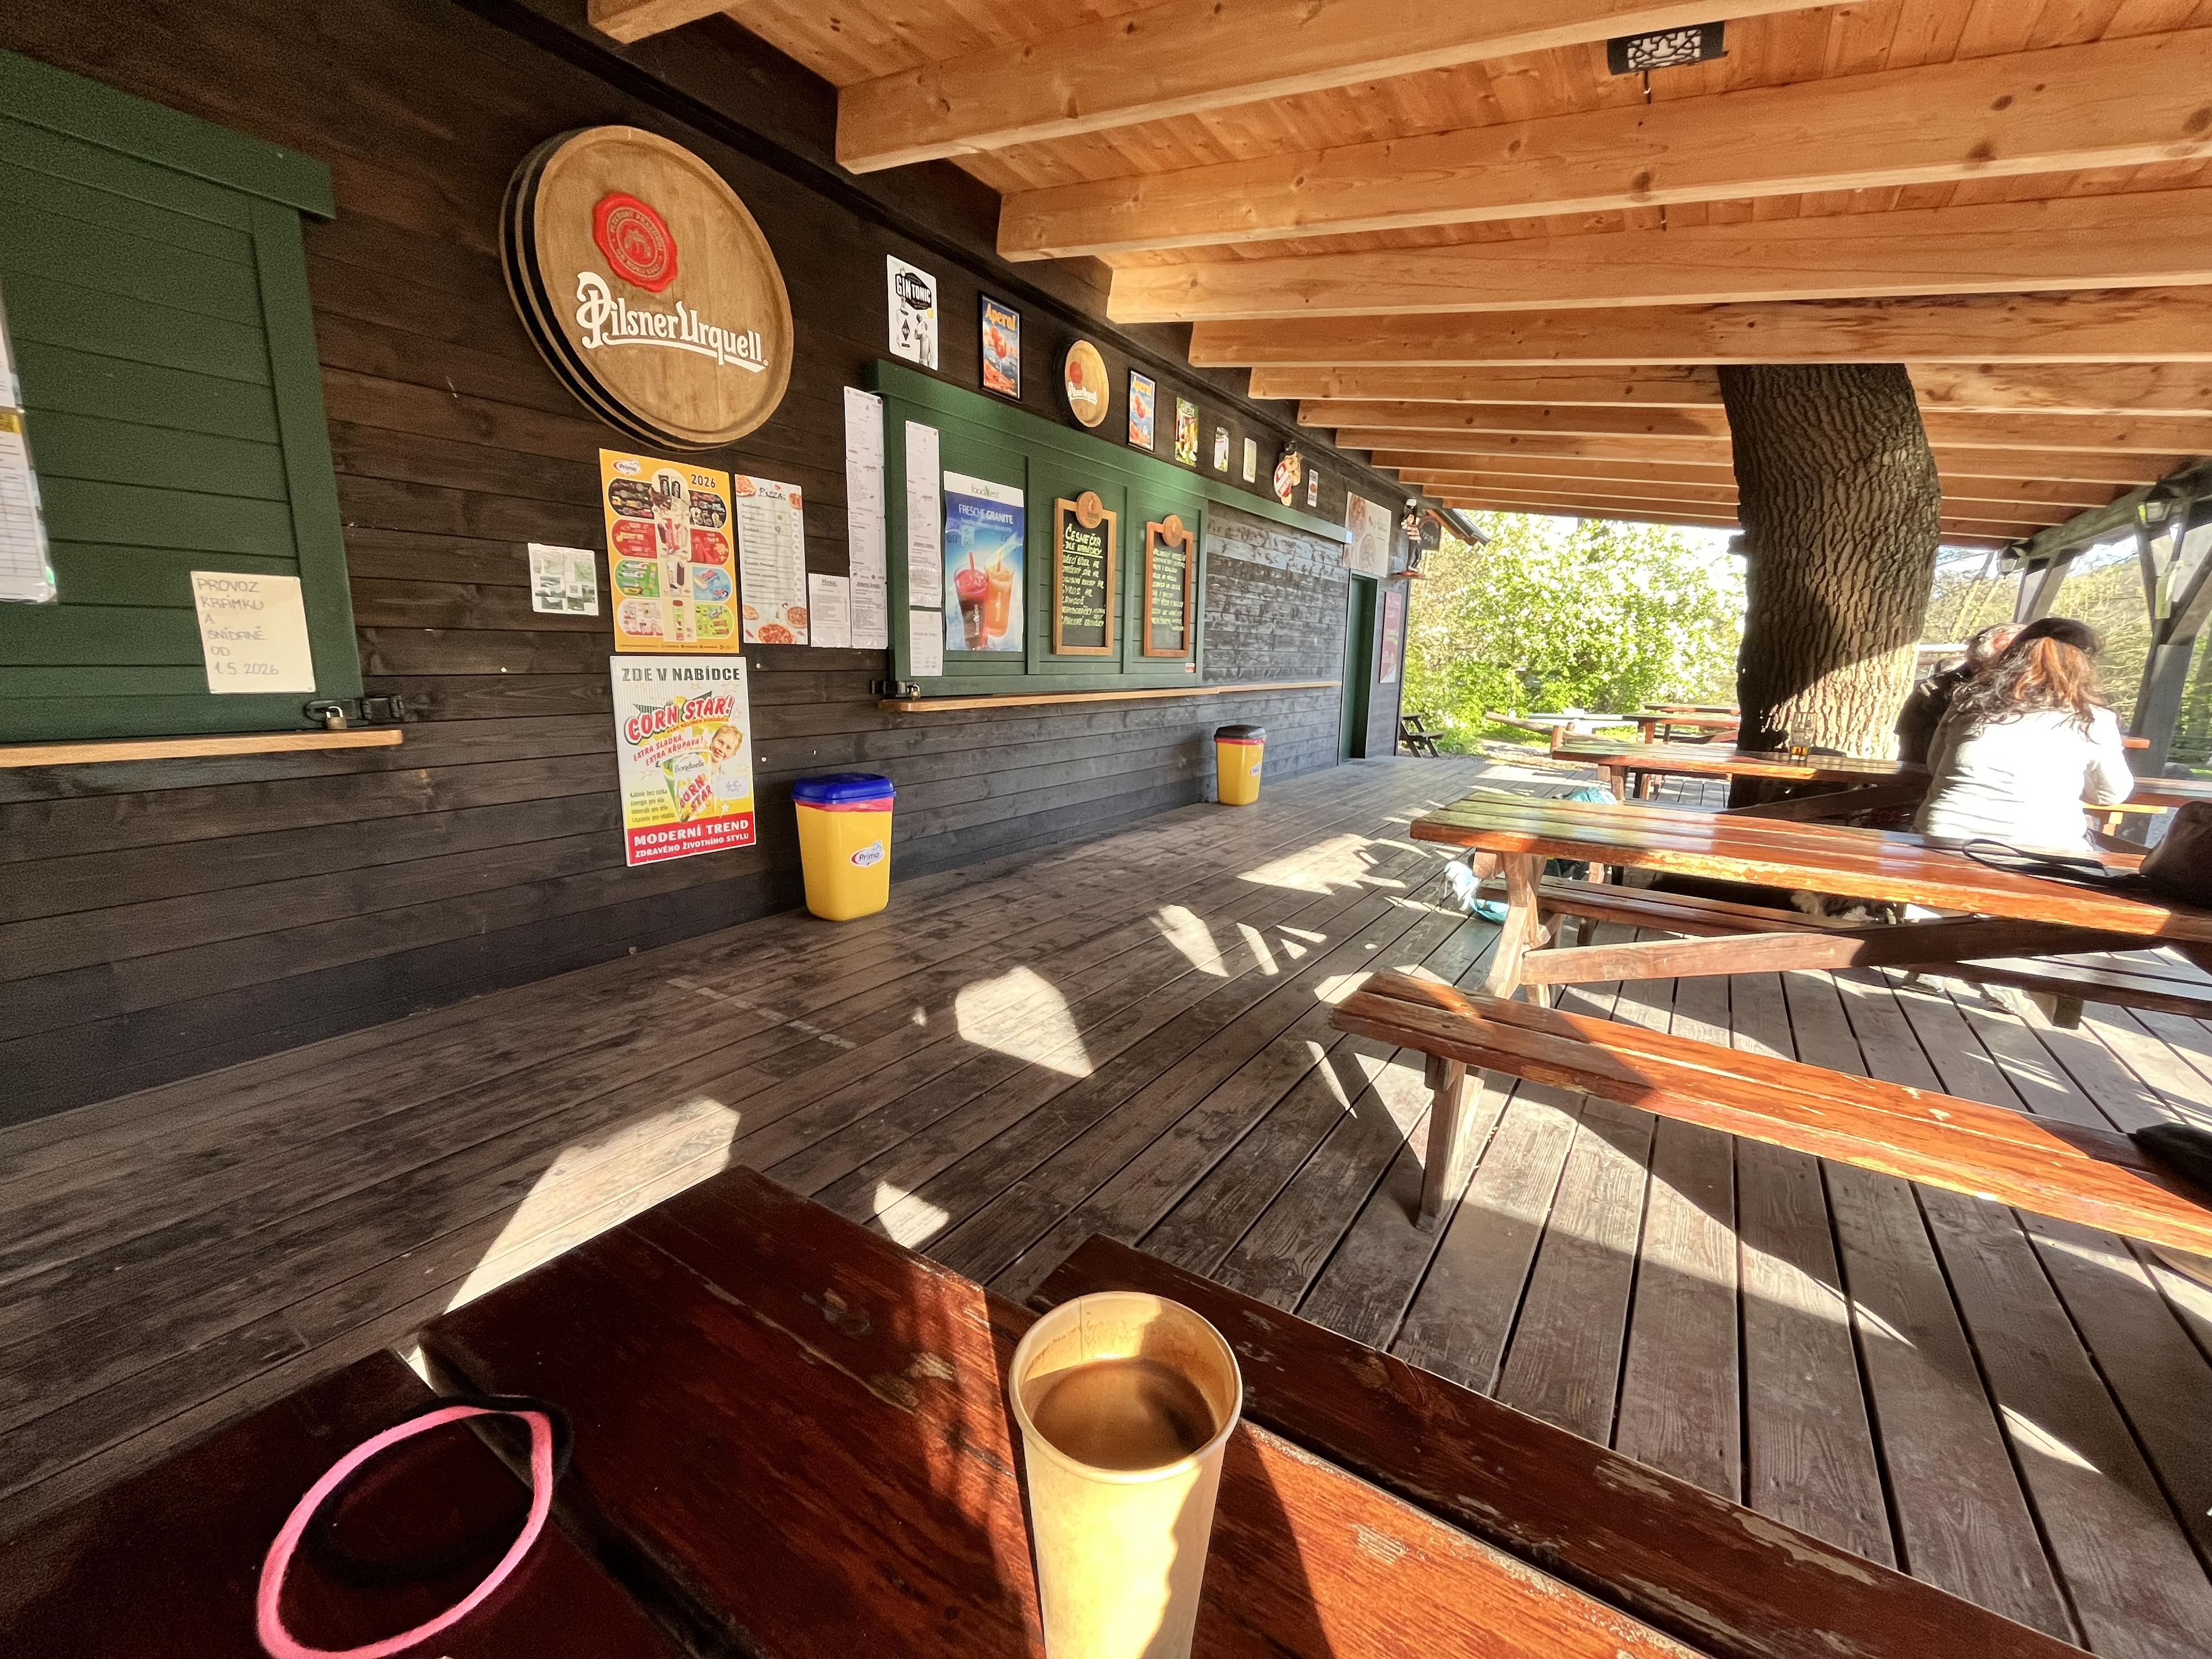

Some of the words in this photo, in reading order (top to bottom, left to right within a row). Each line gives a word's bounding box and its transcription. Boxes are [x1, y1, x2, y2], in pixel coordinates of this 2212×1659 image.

[896, 274, 911, 299] GIN
[911, 283, 931, 303] TONIC
[575, 270, 680, 349] Pilsner
[675, 301, 763, 366] Urquell
[986, 302, 1016, 331] Aperol
[691, 474, 716, 489] 2026
[985, 510, 1014, 524] GRANITE
[1065, 523, 1102, 546] ČESNEČKA
[196, 578, 261, 593] PROVOZ
[200, 594, 264, 611] KRÁMKU
[204, 613, 215, 624] A
[207, 626, 265, 640] SNÍDANĚ
[210, 645, 230, 656] OD
[244, 662, 279, 675] 2026
[622, 668, 653, 681] ZDE
[656, 668, 667, 681] V
[672, 665, 740, 681] NABÍDCE
[628, 705, 679, 742] CORN
[685, 696, 735, 720] STAR!
[633, 746, 654, 761] EXTRA
[646, 750, 666, 766] EXTRA
[675, 760, 705, 773] Bonduelle
[679, 774, 707, 808] CORN
[690, 784, 712, 812] STAR
[634, 824, 702, 847] MODERNÍ
[705, 820, 749, 836] TREND
[634, 844, 681, 859] ZDRAVÉHO
[681, 836, 725, 851] ŽIVOTNÍHO
[726, 832, 749, 843] STYLU
